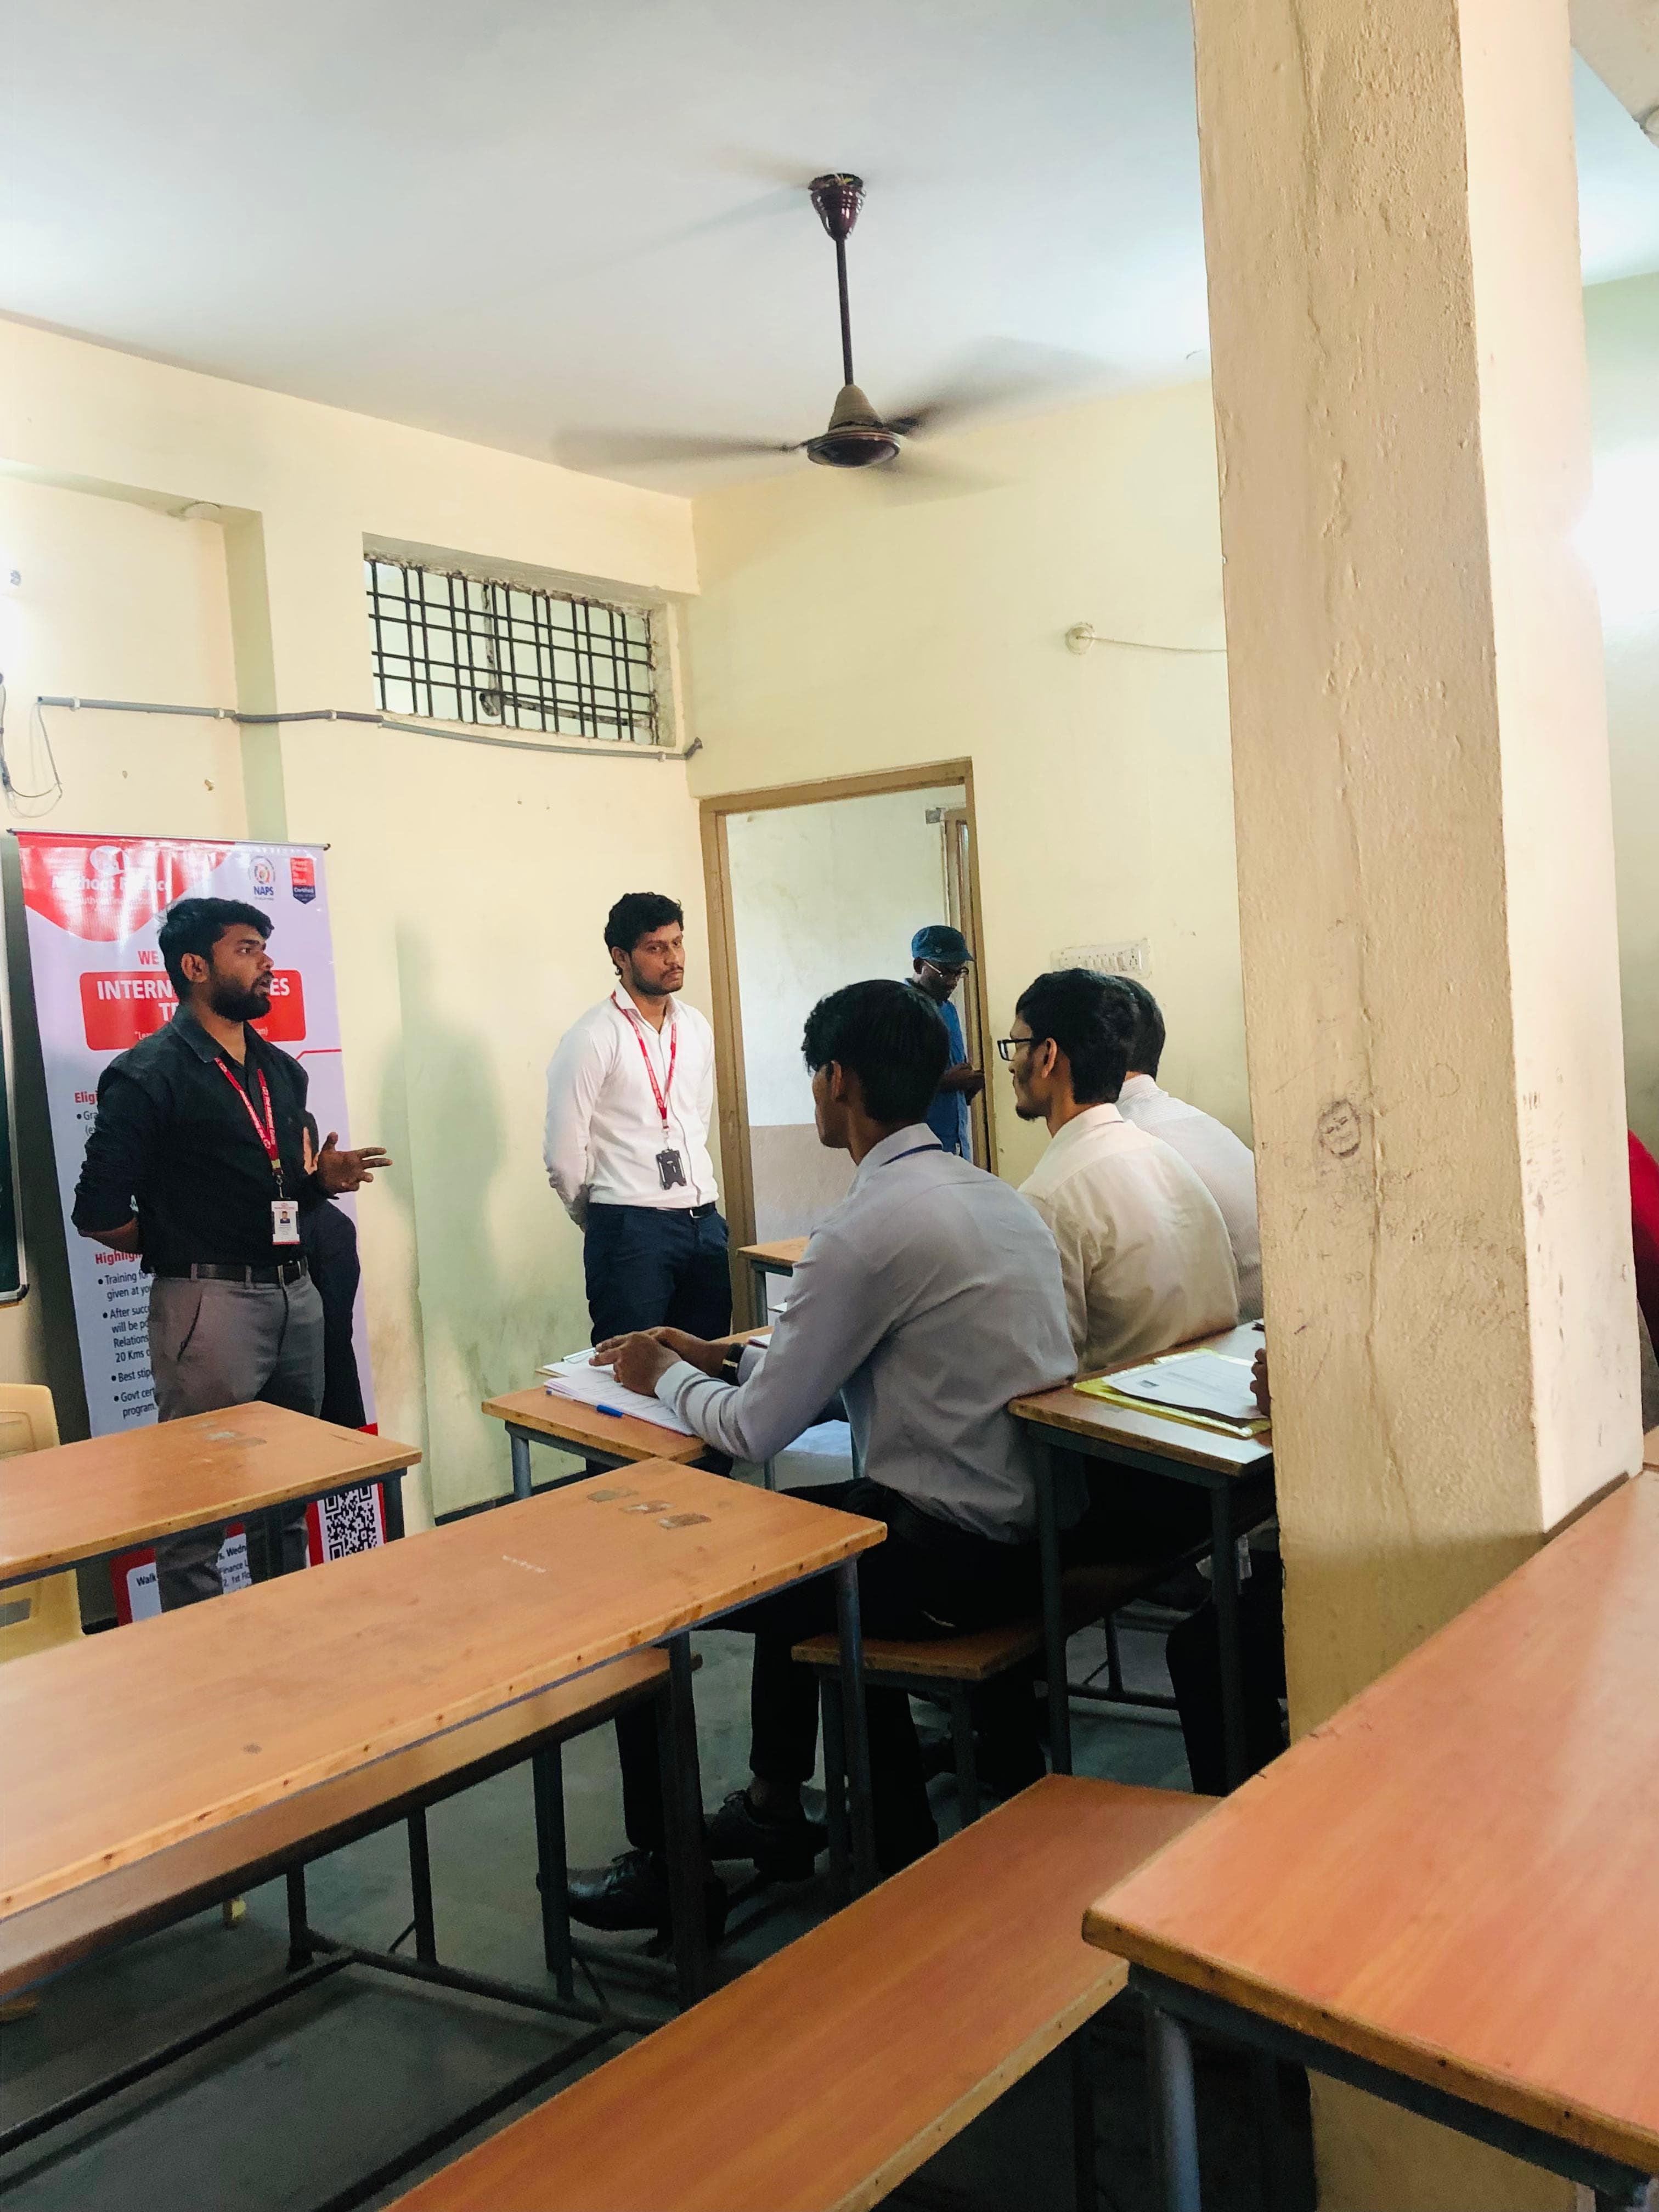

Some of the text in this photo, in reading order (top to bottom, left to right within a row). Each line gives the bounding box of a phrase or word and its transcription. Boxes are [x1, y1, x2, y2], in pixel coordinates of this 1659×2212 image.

[253, 887, 274, 895] NAPS
[138, 951, 159, 965] WE
[104, 1272, 137, 1284] Training
[107, 1289, 129, 1302] given
[131, 1286, 139, 1295] at
[110, 1308, 129, 1319] After
[111, 1321, 126, 1333] will
[128, 1321, 138, 1330] be
[115, 1352, 126, 1363] 20
[128, 1350, 144, 1360] Kms
[119, 1372, 135, 1382] Best
[121, 1391, 139, 1402] Govt
